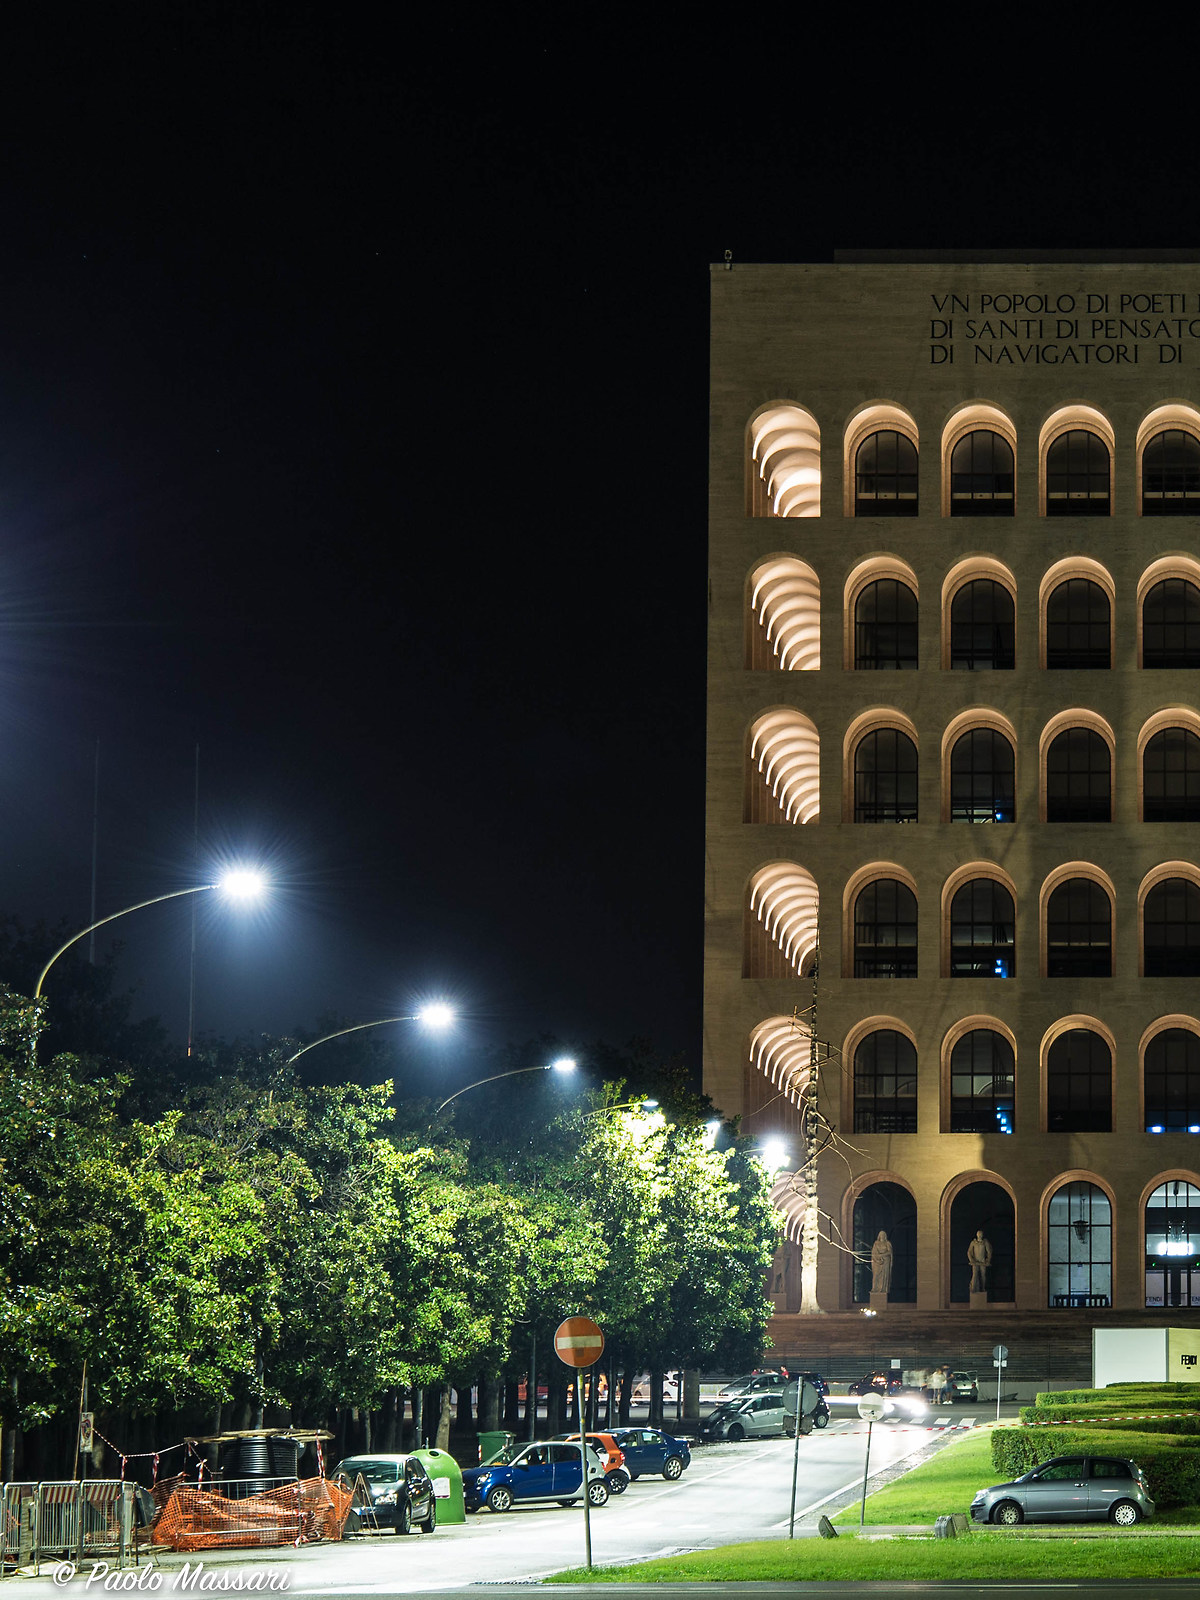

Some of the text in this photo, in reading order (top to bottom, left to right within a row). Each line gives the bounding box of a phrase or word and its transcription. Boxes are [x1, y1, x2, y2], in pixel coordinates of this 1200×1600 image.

[930, 294, 970, 314] VN
[980, 294, 1076, 314] POPOLO
[1085, 293, 1109, 314] DI
[1119, 293, 1186, 314] POETI
[929, 319, 953, 339] DI
[965, 319, 1044, 340] SANTI
[1055, 319, 1079, 339] DI
[929, 344, 954, 365] DI
[974, 344, 1139, 365] NAVIGATORI
[1157, 343, 1183, 364] DI
[1181, 1354, 1197, 1365] FENDI
